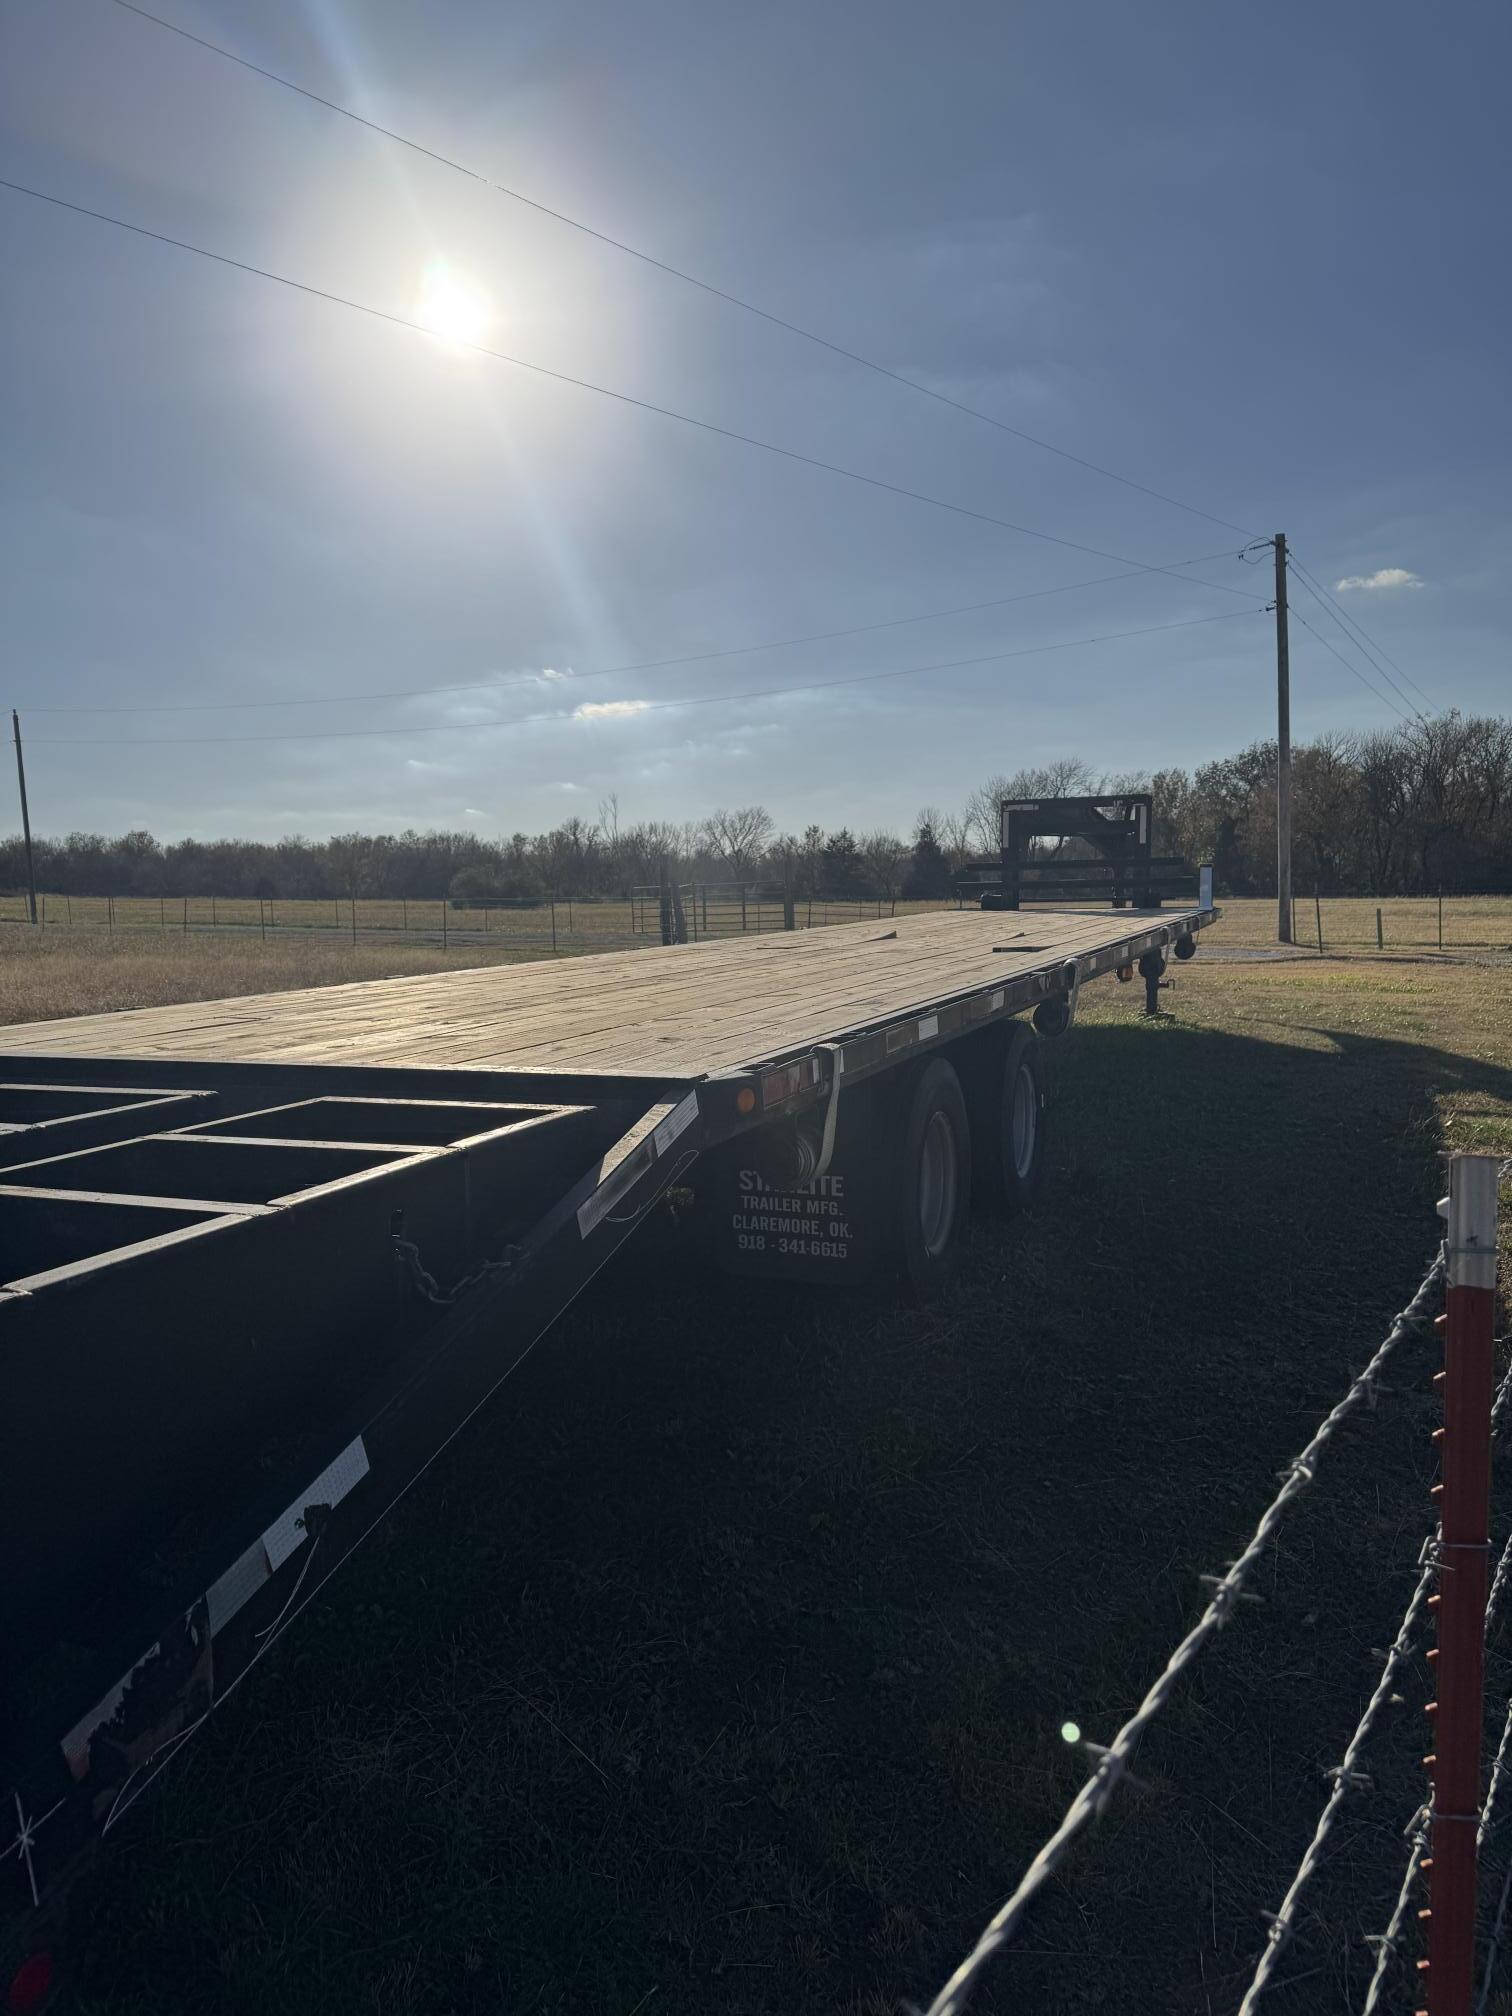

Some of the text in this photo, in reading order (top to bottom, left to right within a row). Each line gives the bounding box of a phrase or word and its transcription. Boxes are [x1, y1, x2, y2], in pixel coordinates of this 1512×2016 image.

[741, 1195, 844, 1216] TRAILER MFG.
[732, 1214, 854, 1239] CLAREMORE, OK.
[738, 1234, 765, 1250] 918
[778, 1237, 848, 1259] 341-6615
